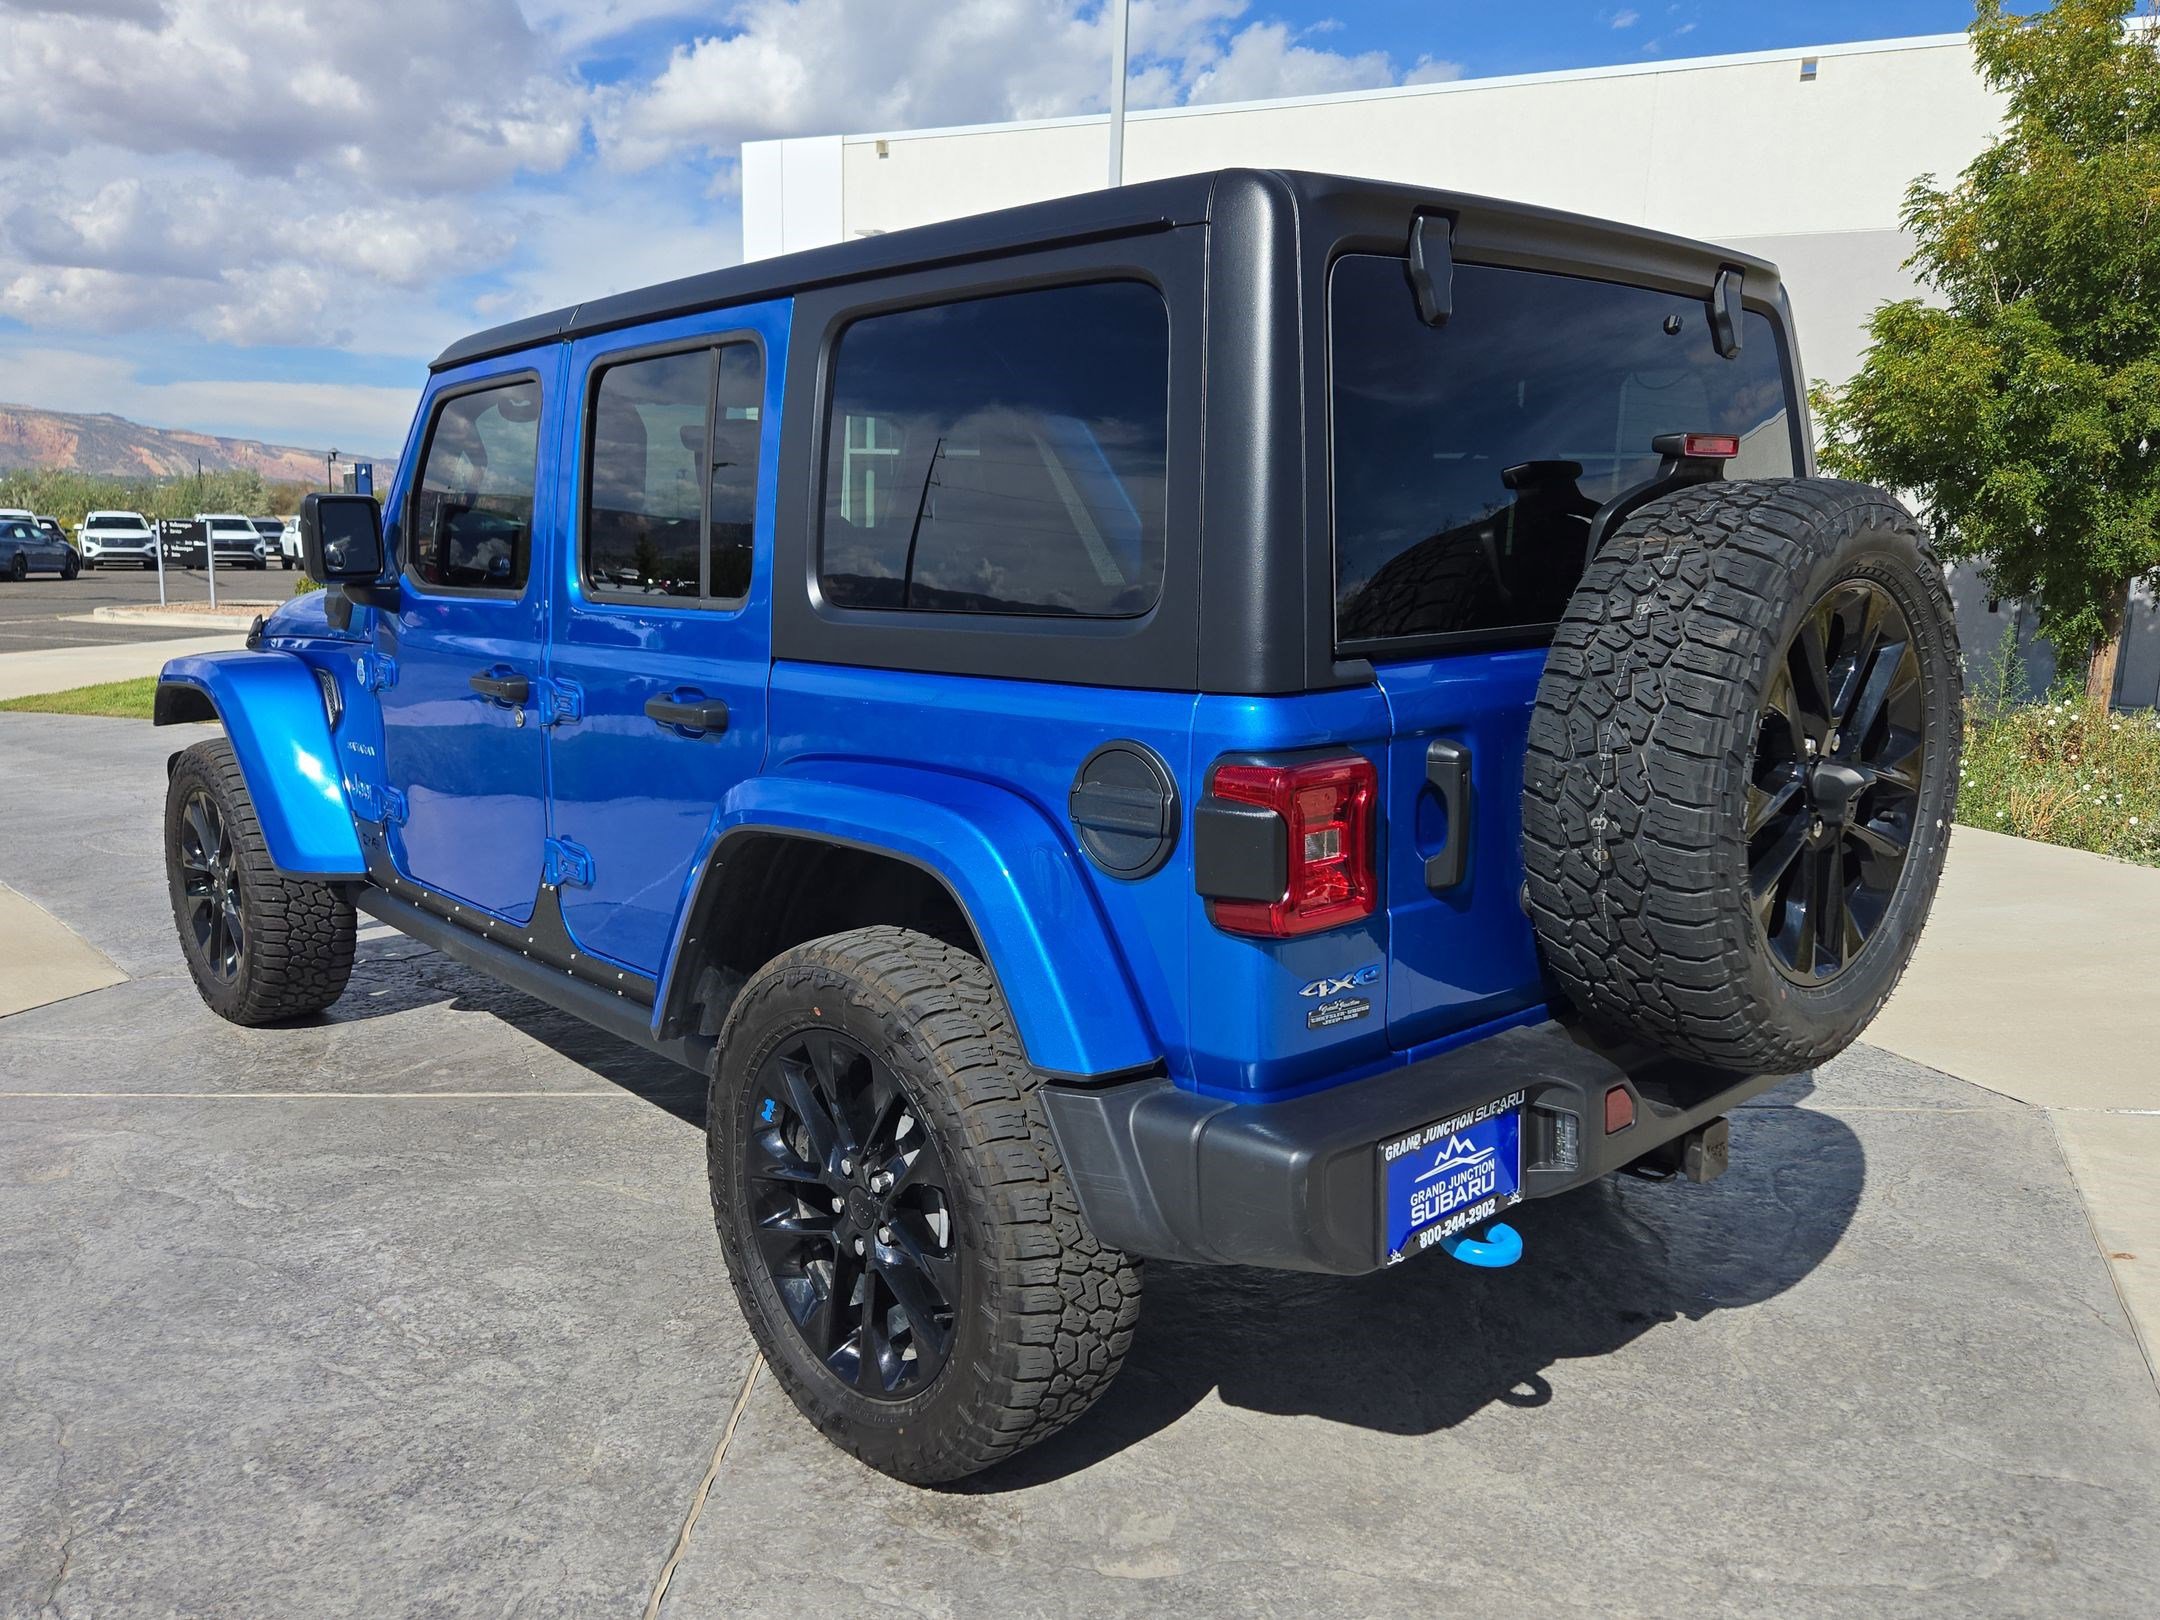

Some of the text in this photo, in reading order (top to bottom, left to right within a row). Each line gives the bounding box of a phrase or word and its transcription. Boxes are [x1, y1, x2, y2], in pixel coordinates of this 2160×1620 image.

[1385, 1090, 1525, 1162] GRAND JUNCTION SUBARU
[1411, 1158, 1495, 1207] GRAND JUNCTION
[1411, 1171, 1495, 1227] SUBARU
[1419, 1198, 1496, 1249] 800-244-2902
